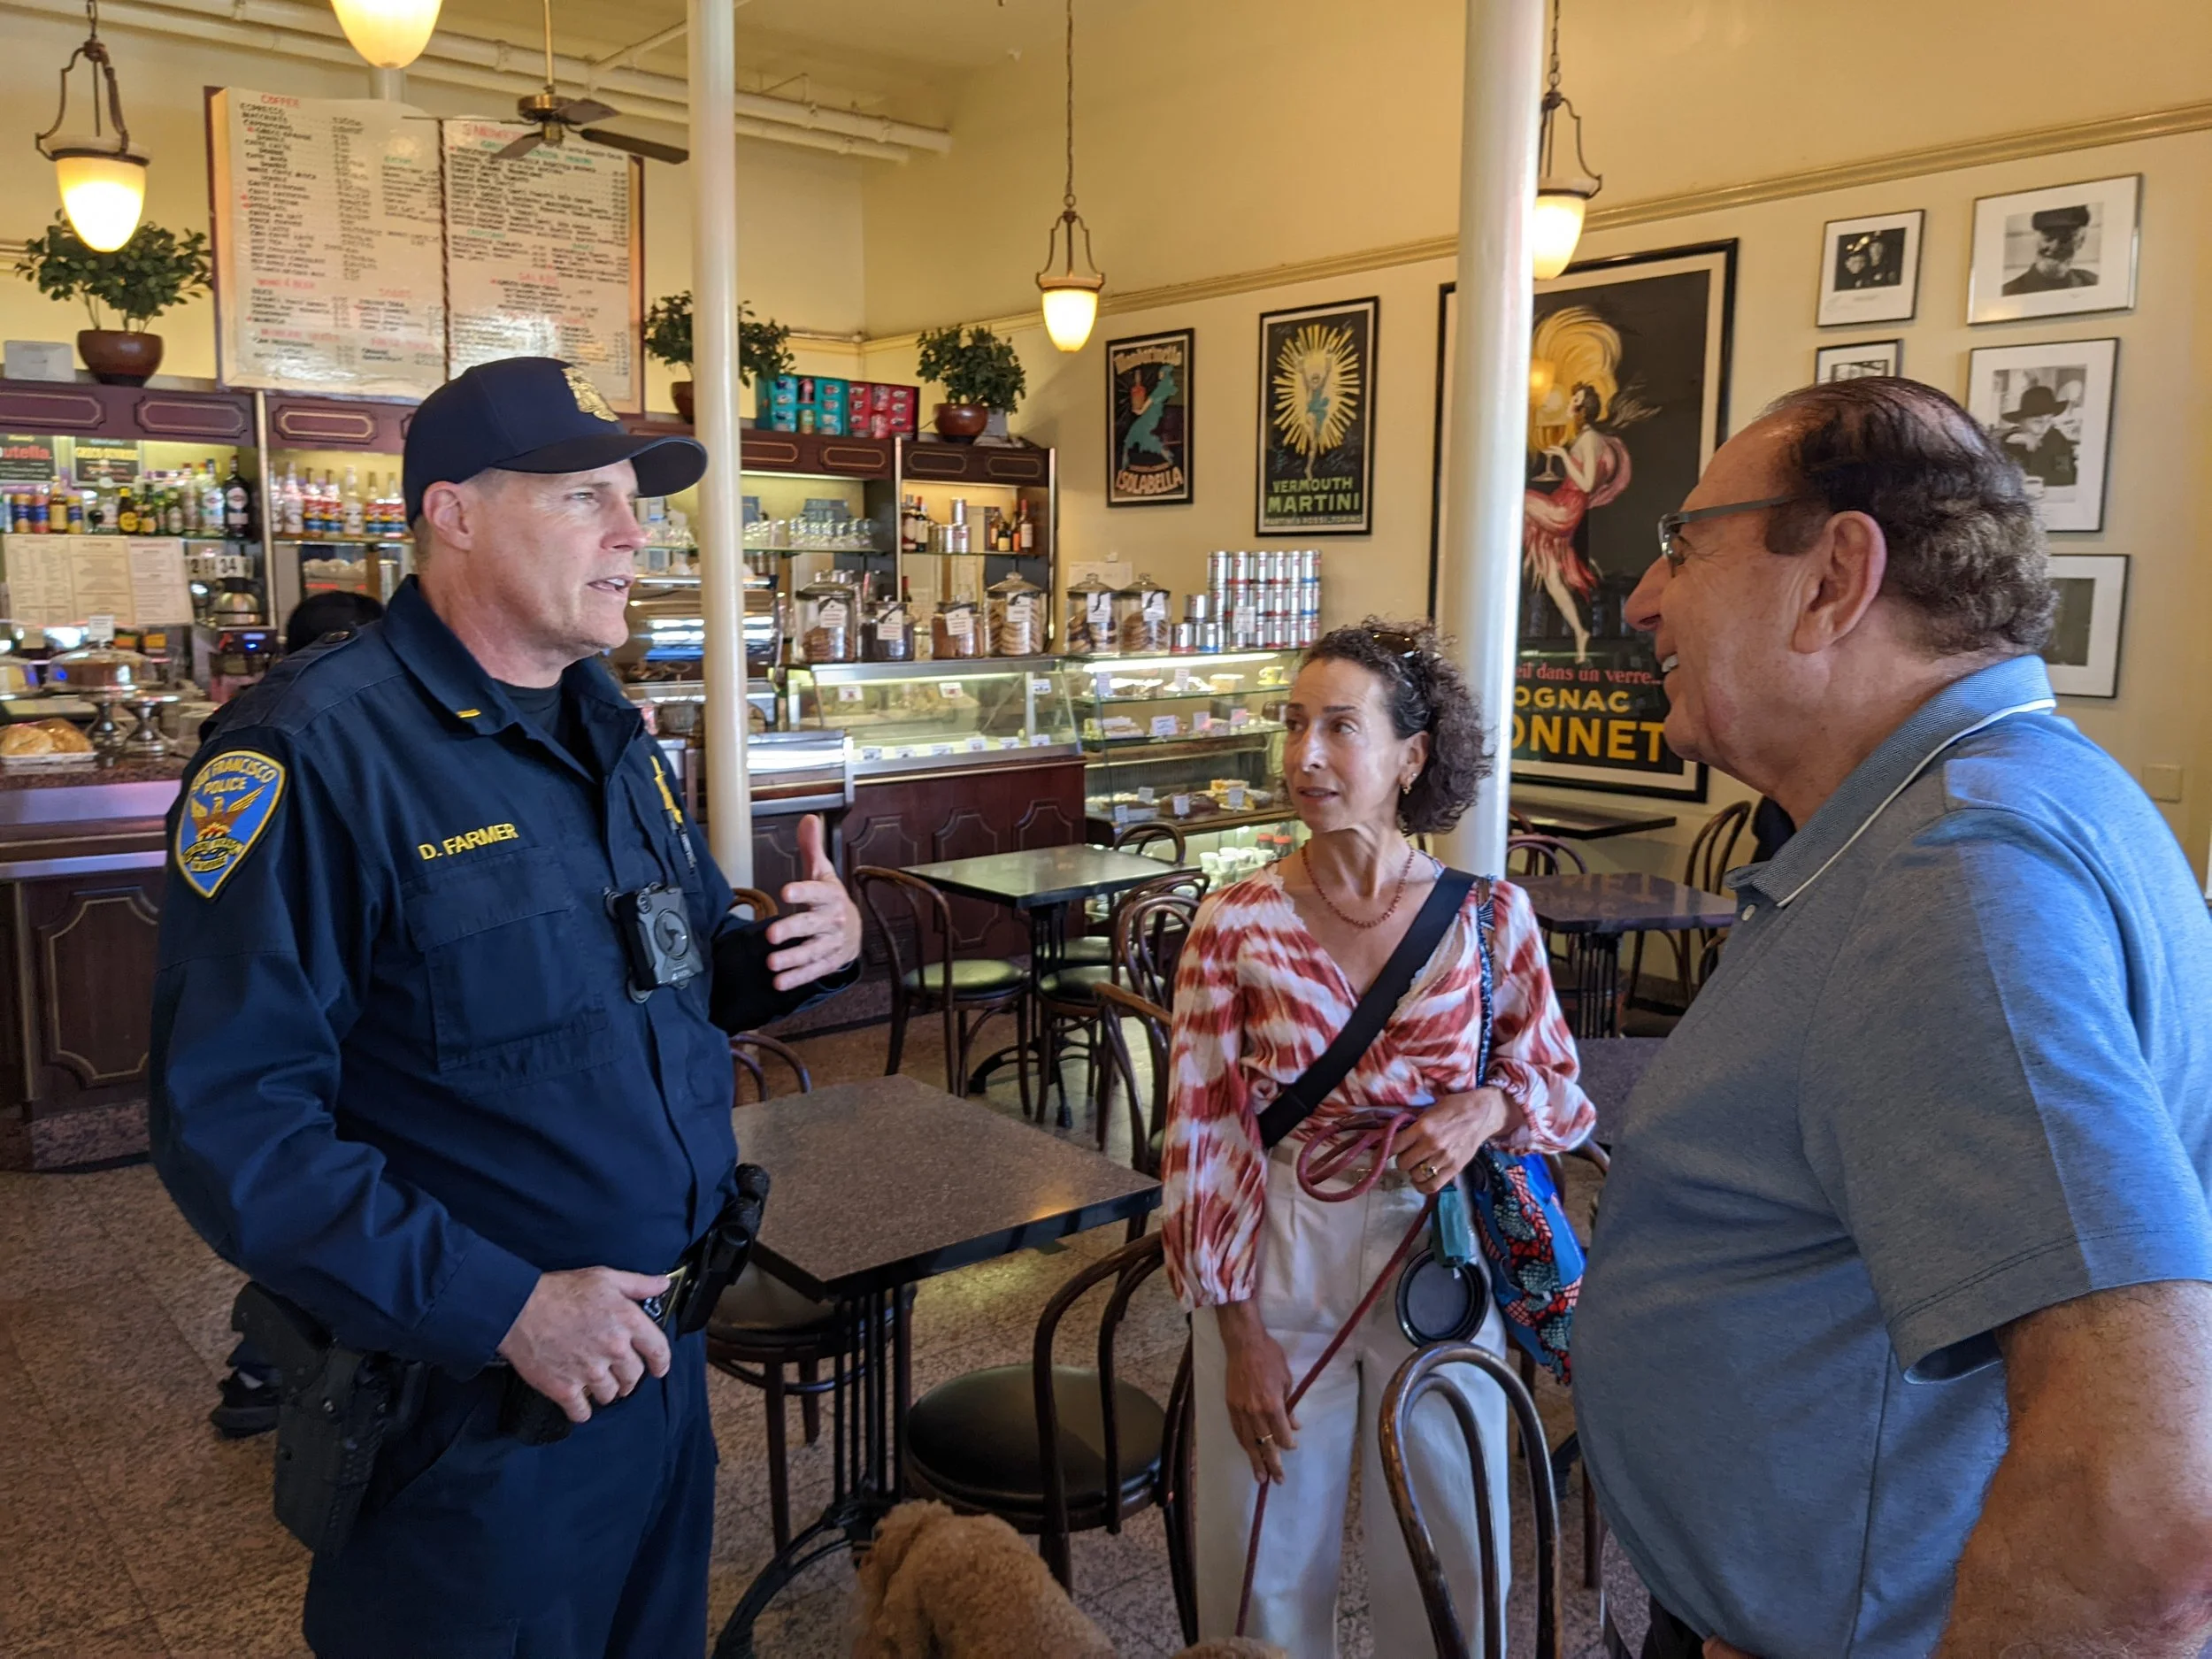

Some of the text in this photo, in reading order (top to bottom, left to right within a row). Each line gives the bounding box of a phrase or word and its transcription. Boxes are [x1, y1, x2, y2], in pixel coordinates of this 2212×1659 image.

[1117, 466, 1184, 495] ISOLABELLA
[1272, 477, 1353, 493] VERMOUTH
[1267, 493, 1360, 513] MARTINI
[1536, 662, 1574, 680] dans
[1578, 665, 1601, 682] un
[1514, 687, 1630, 713] OGNAC
[1511, 715, 1665, 763] ONNET
[211, 757, 278, 784] FRANCISCO
[204, 776, 248, 795] POLICE
[418, 823, 519, 860] D. FARMER
